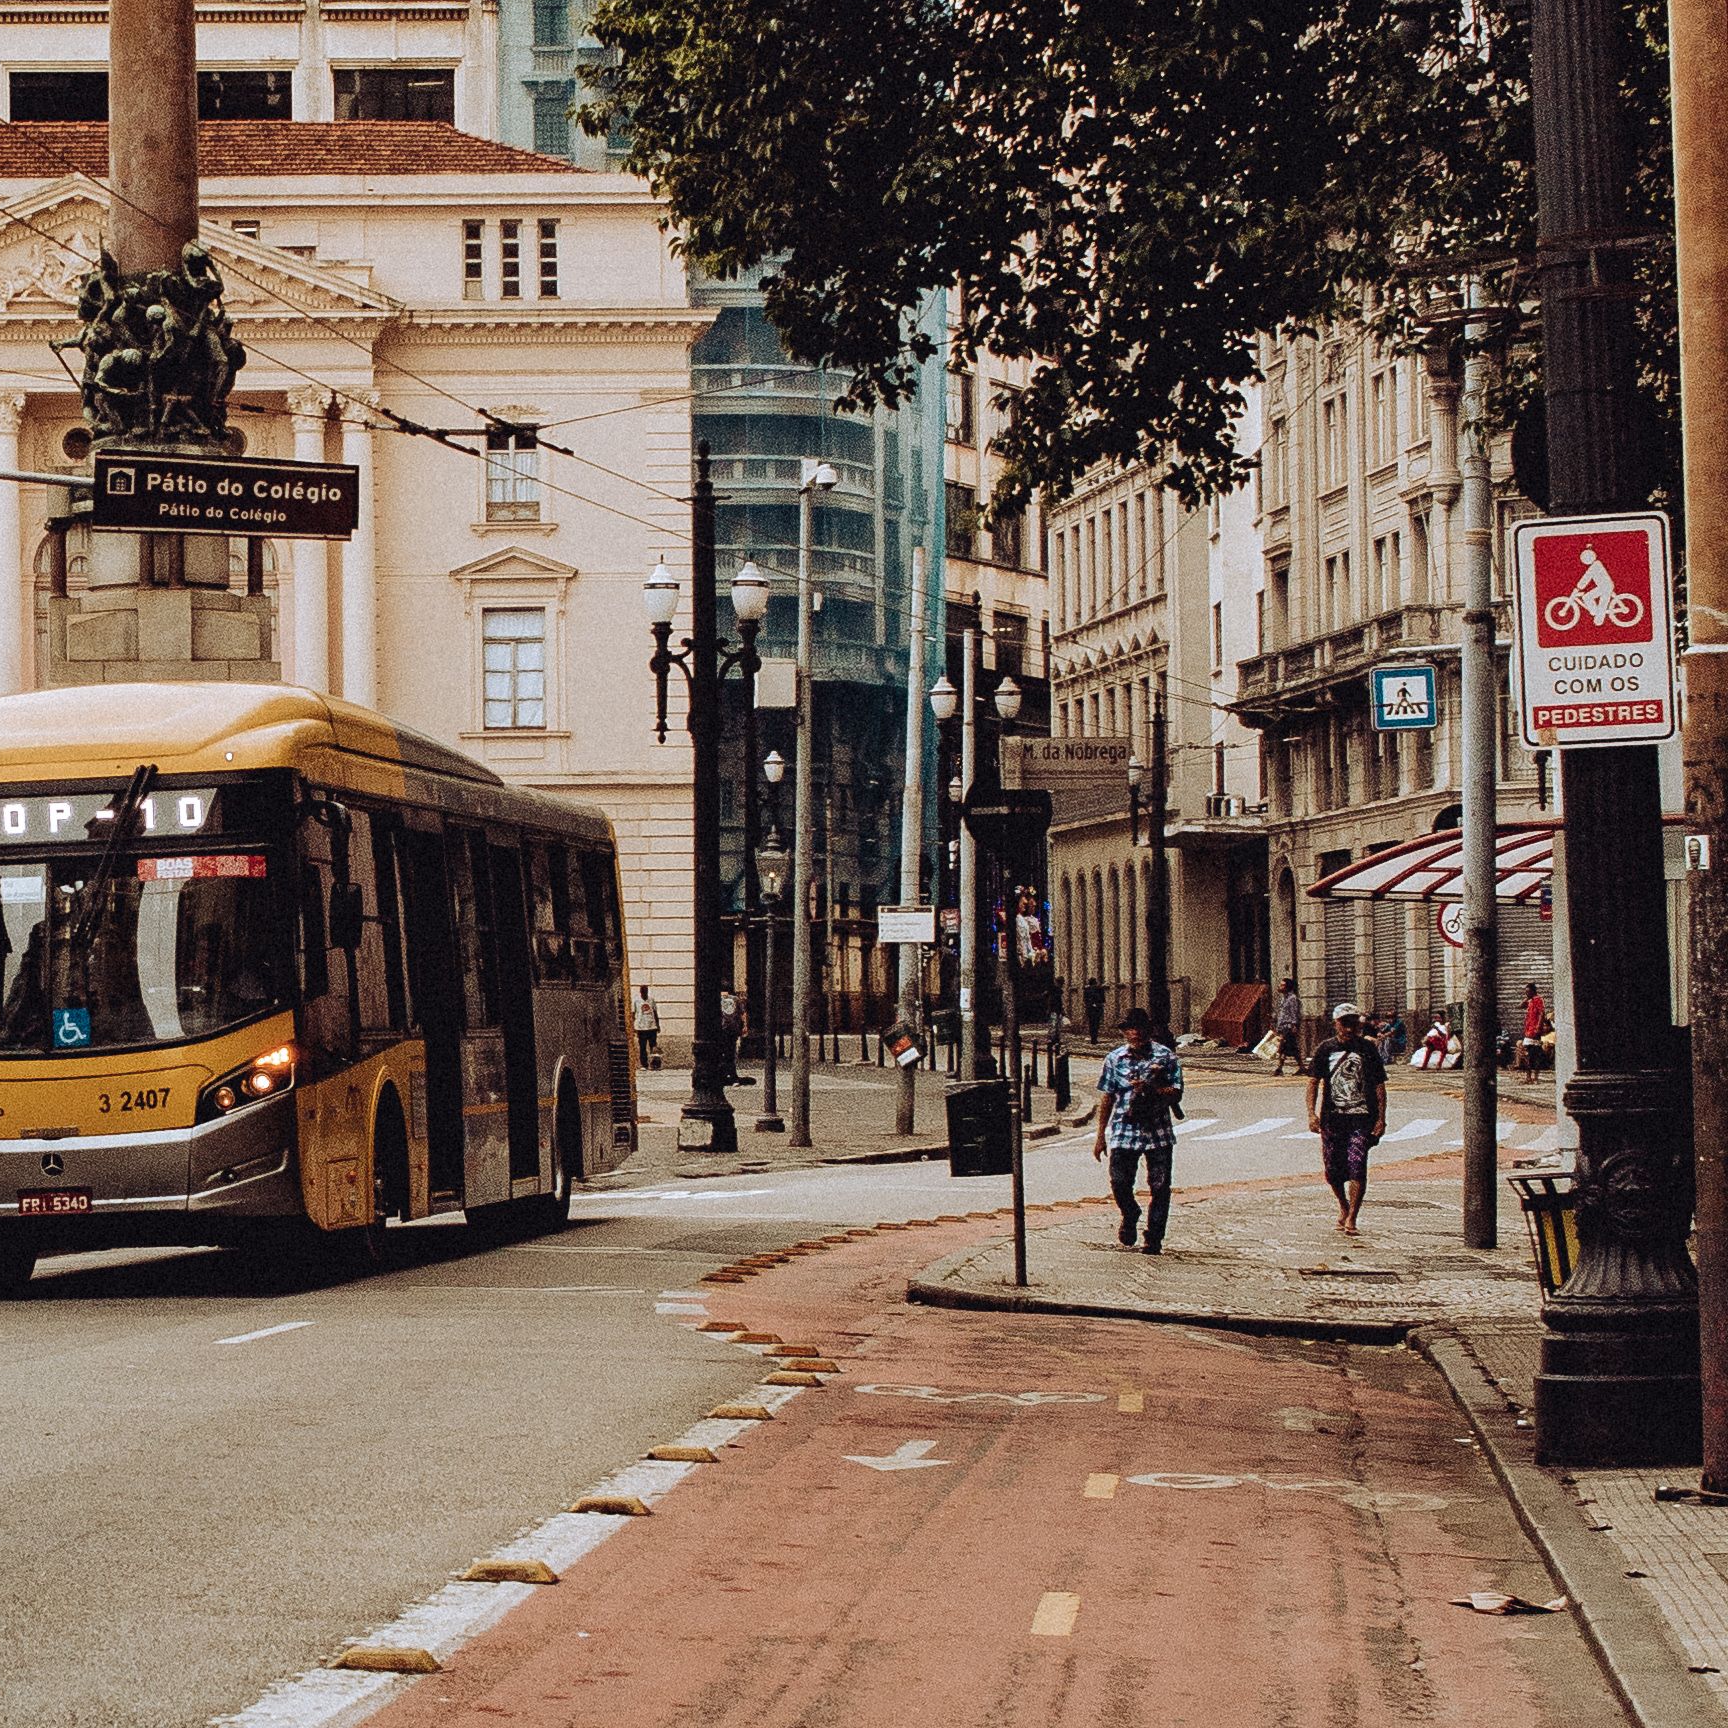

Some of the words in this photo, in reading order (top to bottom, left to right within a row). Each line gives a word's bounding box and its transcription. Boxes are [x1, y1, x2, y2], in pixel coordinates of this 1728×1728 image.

[147, 472, 208, 494] Pátio
[216, 478, 244, 496] do
[253, 480, 342, 504] Colégio
[159, 503, 200, 518] Pátio
[205, 506, 223, 518] do
[229, 508, 287, 524] Colégio
[1548, 652, 1644, 672] CUIDADO
[1554, 678, 1602, 695] COM
[1610, 676, 1640, 692] OS
[1537, 703, 1659, 726] PEDESTRES
[1023, 744, 1038, 760] M.
[1042, 744, 1061, 760] da
[98, 1094, 112, 1114] 3
[120, 1088, 171, 1112] 2407
[53, 1196, 88, 1211] 5340
